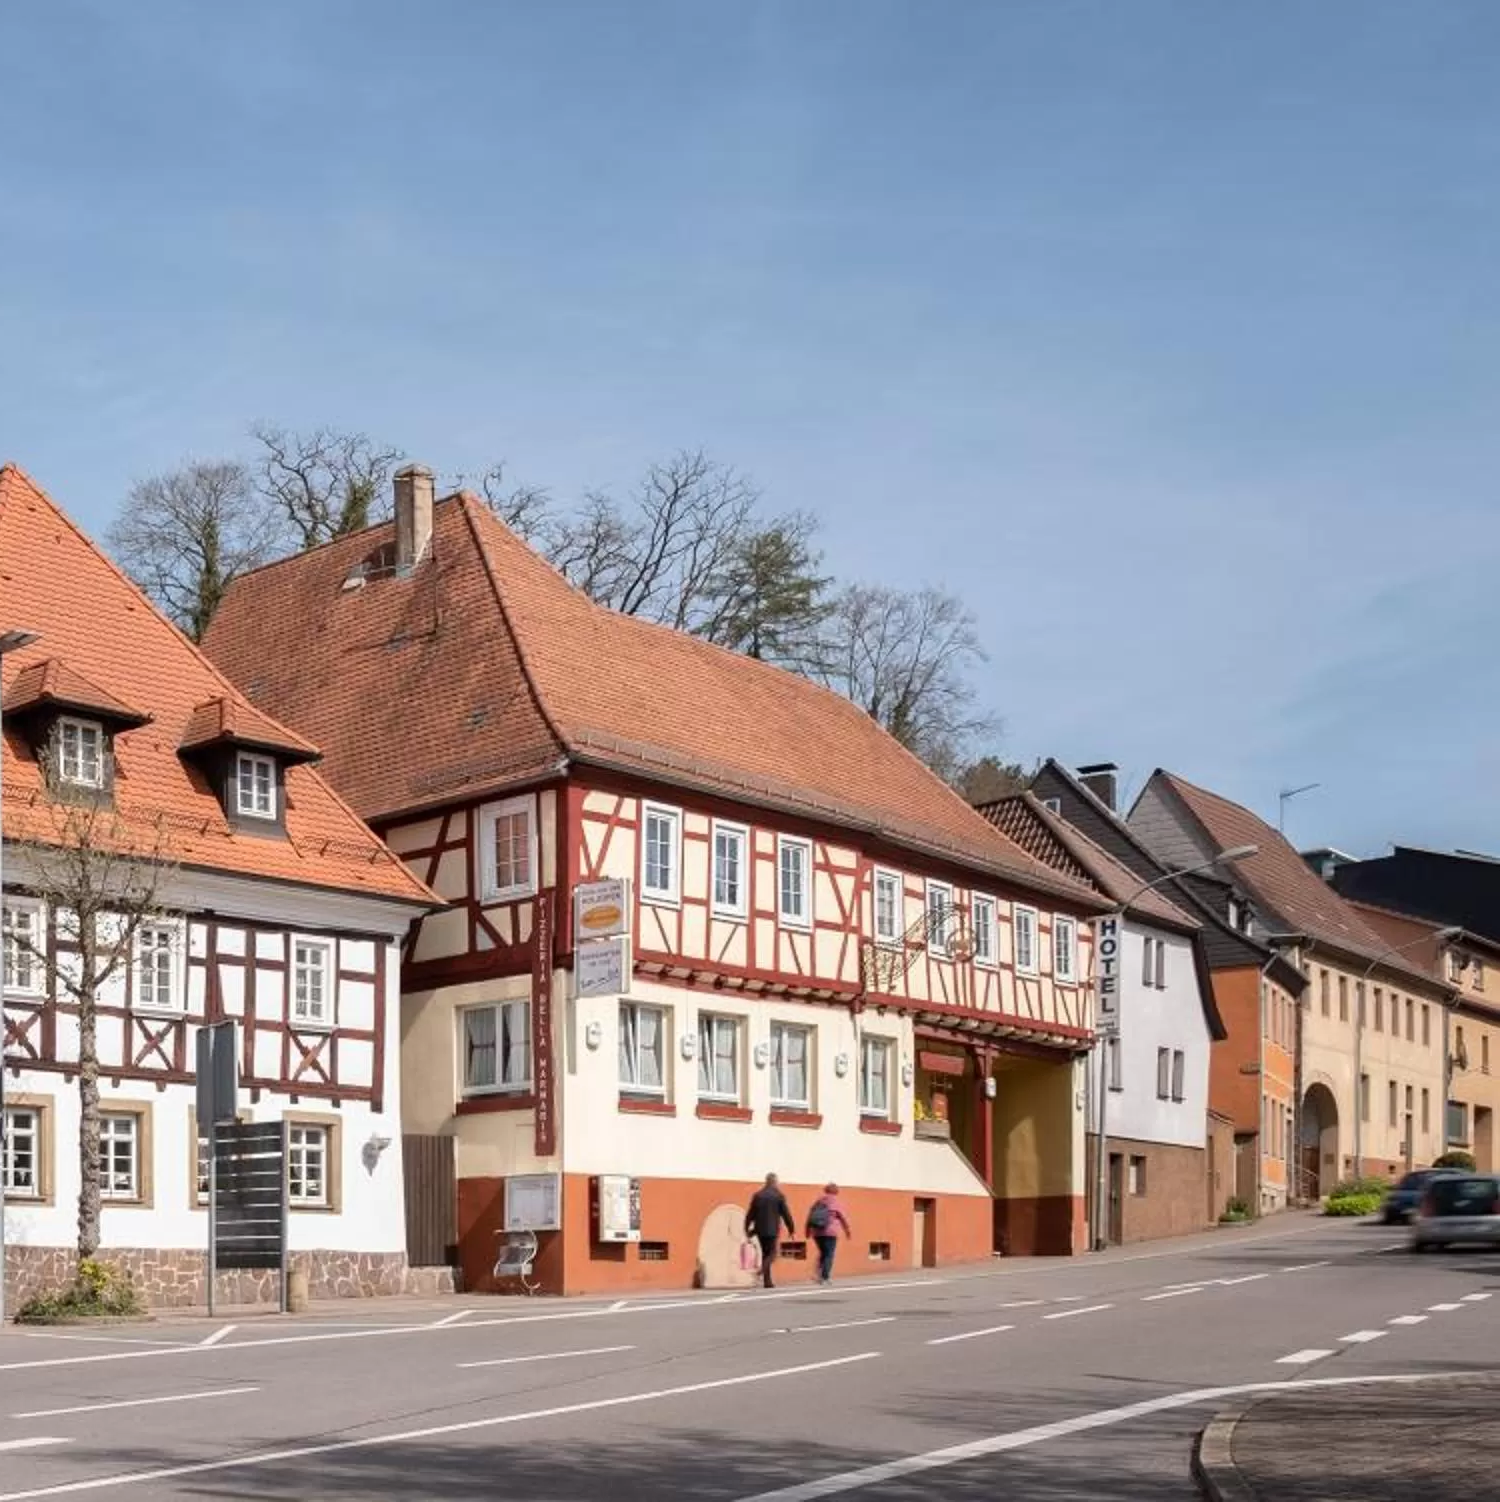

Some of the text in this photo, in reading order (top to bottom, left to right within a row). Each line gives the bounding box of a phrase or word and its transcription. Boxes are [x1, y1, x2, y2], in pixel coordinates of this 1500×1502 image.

[539, 897, 547, 982] PIZZERIA
[1100, 919, 1117, 1015] HOTEL
[539, 993, 547, 1047] BELLA
